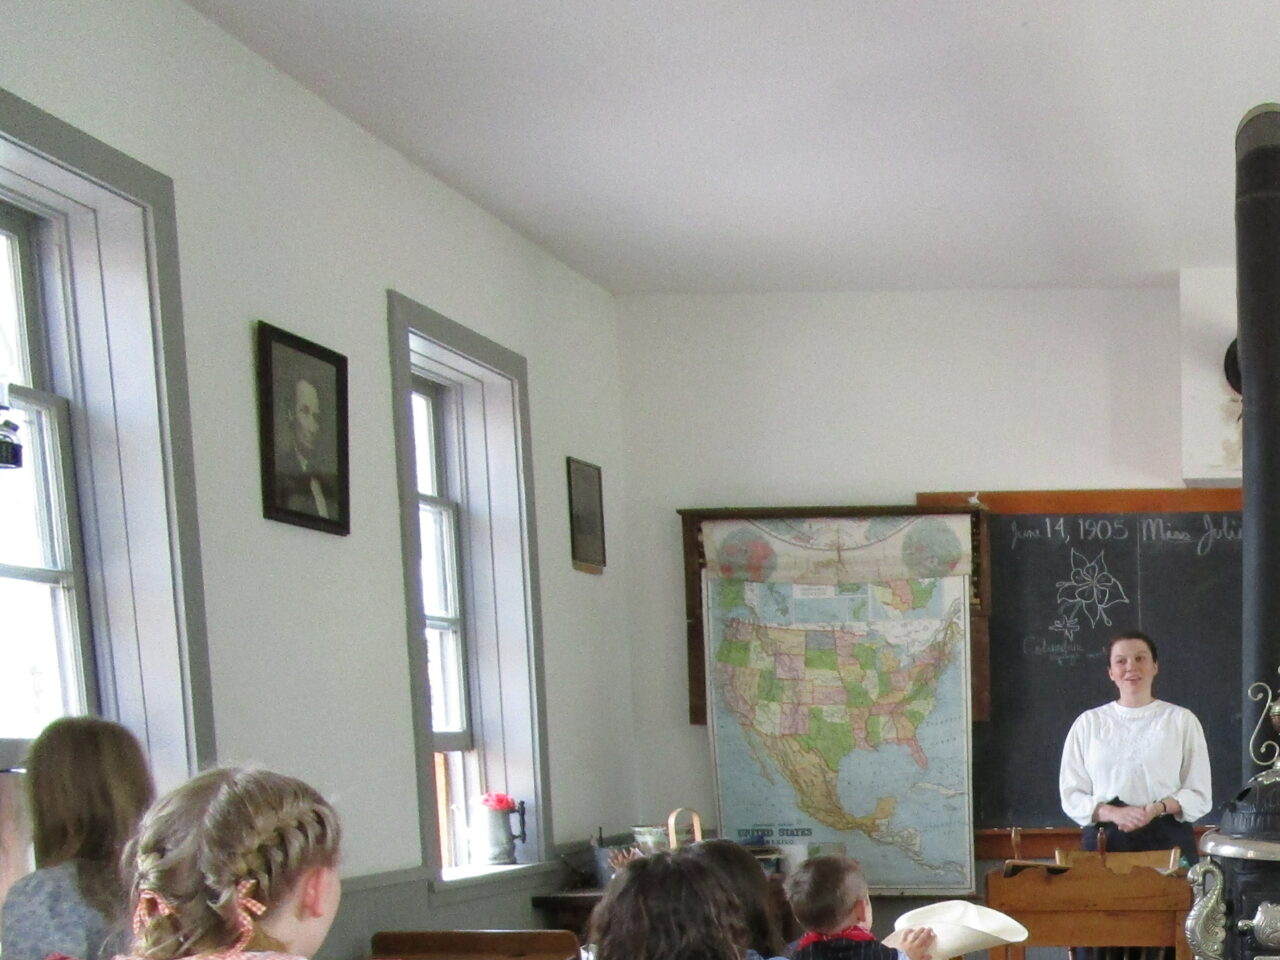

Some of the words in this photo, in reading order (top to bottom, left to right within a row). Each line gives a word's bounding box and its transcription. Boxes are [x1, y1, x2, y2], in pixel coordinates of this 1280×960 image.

[1078, 518, 1129, 540] 1905
[1141, 517, 1193, 543] Miss
[779, 828, 813, 837] STATES
